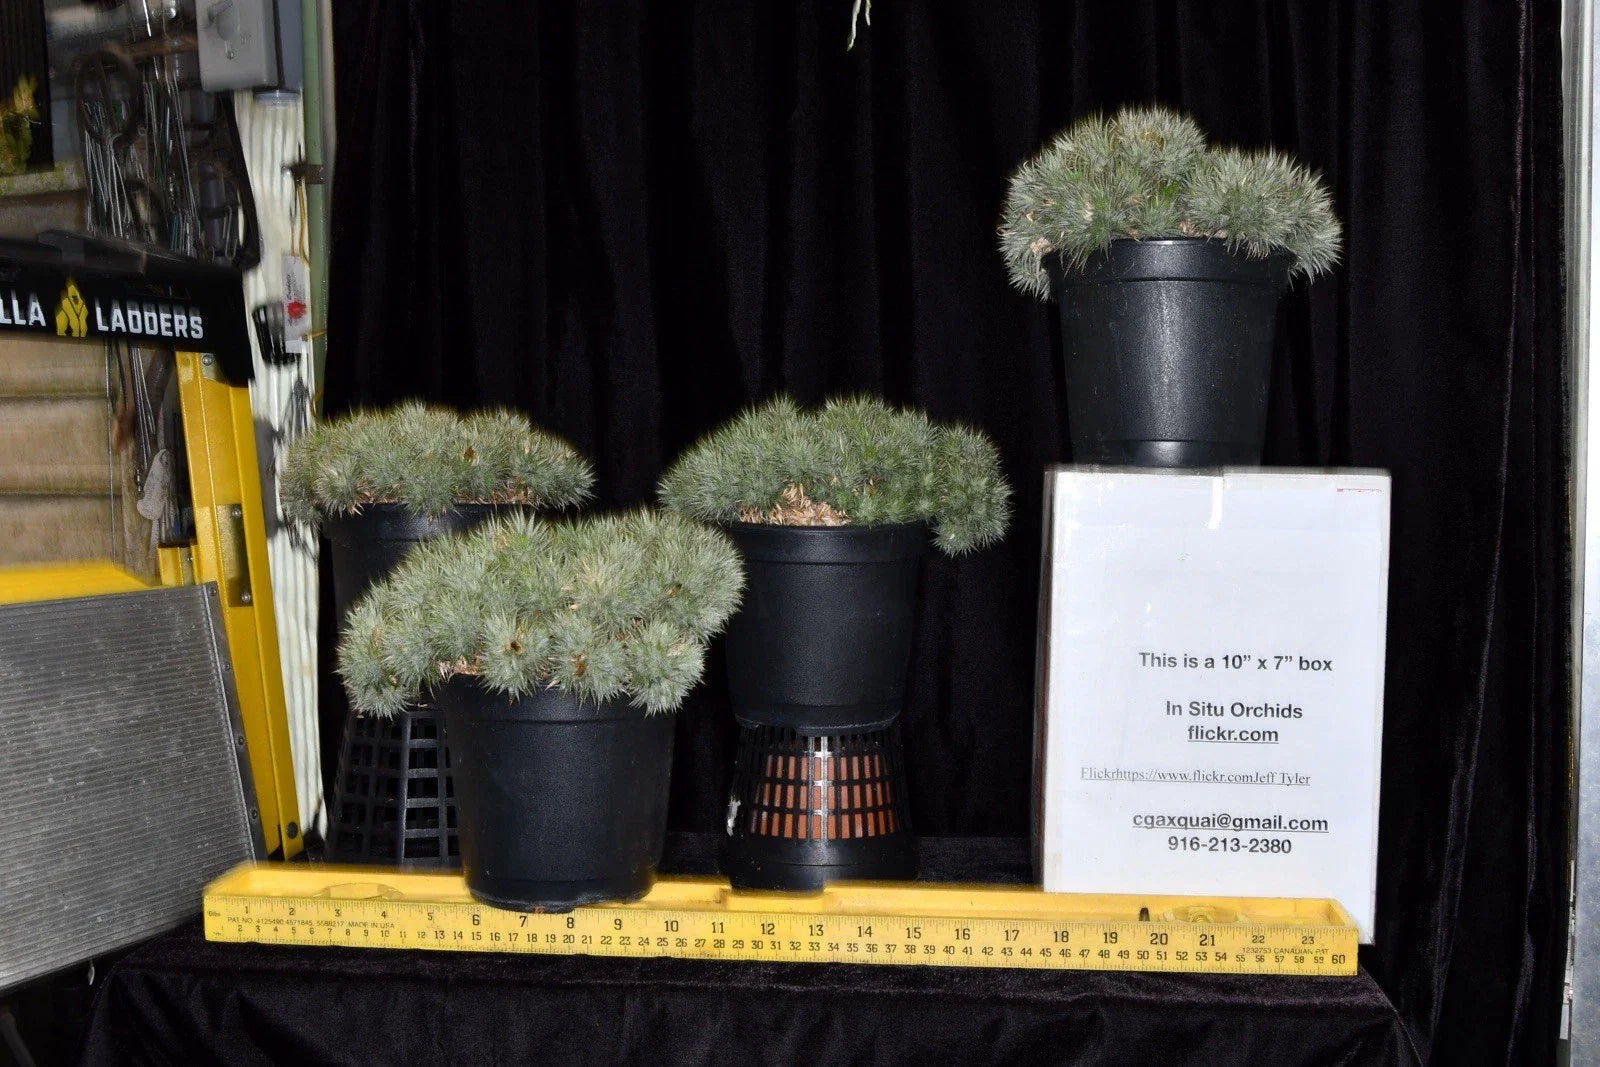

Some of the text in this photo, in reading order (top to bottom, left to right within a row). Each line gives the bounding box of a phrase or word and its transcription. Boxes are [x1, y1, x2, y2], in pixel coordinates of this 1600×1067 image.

[95, 301, 204, 339] LADDERS
[1138, 652, 1177, 668] This
[1183, 654, 1198, 668] is
[1204, 656, 1215, 669] a
[1257, 658, 1268, 670] x
[1299, 656, 1333, 672] box
[1166, 701, 1303, 719] In Situ Orchids
[1188, 726, 1279, 744] flickr.com
[1280, 772, 1310, 786] Tyler
[1132, 813, 1329, 832] cgaxquai@gmail.com
[1168, 836, 1292, 854] 916-213-2380
[289, 907, 295, 916] 2
[335, 909, 341, 917] 3
[381, 910, 387, 919] 4
[427, 912, 433, 921] 5
[472, 914, 480, 925] 6
[519, 916, 527, 928] 7
[566, 917, 574, 928] 8
[614, 919, 622, 930] 9
[665, 920, 679, 932] 10
[712, 922, 724, 933] 11
[761, 923, 775, 935] 12
[809, 925, 824, 936] 13
[858, 926, 873, 937] 14
[906, 927, 922, 939] 15
[956, 929, 971, 940] 16
[1004, 930, 1019, 941] 17
[1054, 931, 1069, 943] 18
[1103, 932, 1118, 944] 19
[1150, 932, 1168, 945] 20
[1200, 934, 1215, 946] 21
[1252, 935, 1265, 944] 22
[1302, 936, 1315, 944] 23
[309, 927, 314, 935] 6
[364, 929, 368, 937] 9
[400, 930, 407, 938] 11
[435, 930, 445, 939] 13
[453, 931, 463, 940] 14
[472, 932, 481, 940] 15
[490, 932, 500, 941] 16
[508, 933, 519, 942] 17
[527, 933, 537, 943] 18
[545, 934, 556, 943] 19
[563, 934, 574, 943] 20
[582, 935, 592, 944] 21
[601, 935, 612, 944] 22
[620, 936, 631, 945] 23
[638, 937, 650, 946] 24
[657, 937, 668, 946] 25
[676, 938, 687, 947] 26
[695, 938, 706, 948] 27
[713, 939, 725, 948] 28
[732, 939, 744, 949] 29
[751, 940, 763, 949] 30
[770, 941, 781, 950] 31
[789, 942, 801, 951] 32
[809, 942, 820, 951] 33
[828, 943, 840, 952] 34
[847, 943, 858, 952] 35
[866, 944, 878, 953] 36
[885, 944, 897, 953] 37
[904, 945, 916, 954] 38
[924, 945, 935, 954] 39
[943, 945, 955, 955] 40
[962, 946, 973, 955] 41
[981, 946, 993, 956] 42
[1001, 947, 1012, 956] 43
[1020, 947, 1032, 957] 44
[1040, 948, 1051, 957] 45
[1059, 948, 1071, 958] 46
[1079, 949, 1090, 958] 47
[1098, 950, 1110, 959] 48
[1117, 950, 1130, 959] 49
[1137, 951, 1149, 960] 50
[1156, 951, 1168, 960] 51
[1176, 952, 1188, 961] 52
[1195, 952, 1207, 961] 53
[1215, 952, 1228, 962] 54
[1236, 954, 1246, 962] 55
[1255, 955, 1265, 963] 56
[1275, 955, 1285, 963] 57
[1314, 956, 1324, 964] 59
[1331, 954, 1345, 964] 60
